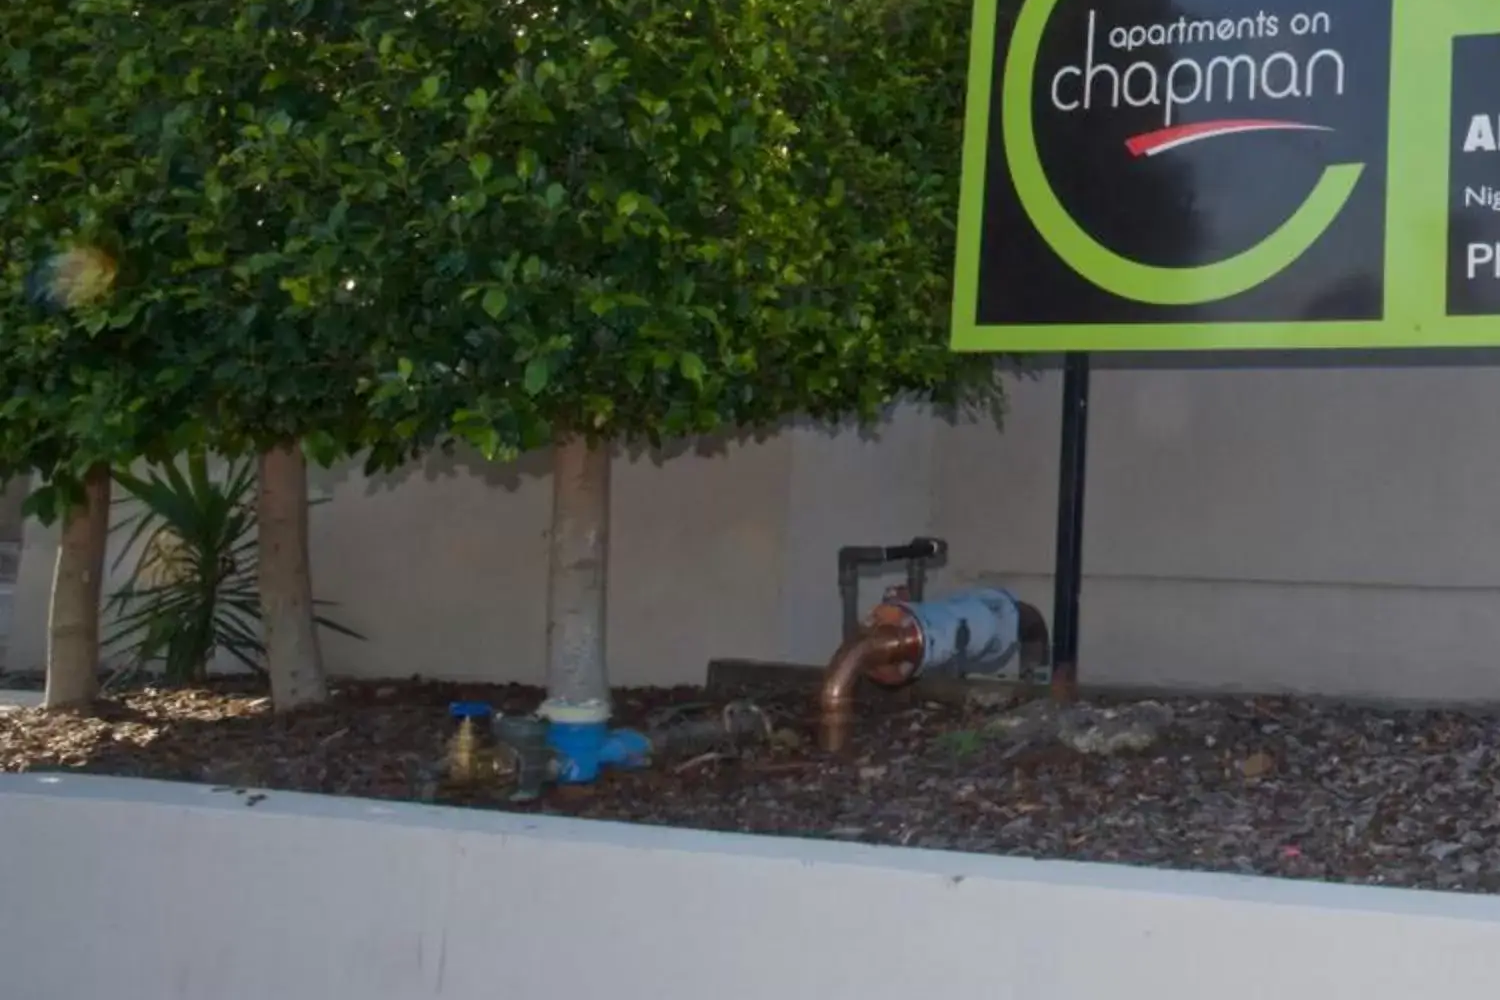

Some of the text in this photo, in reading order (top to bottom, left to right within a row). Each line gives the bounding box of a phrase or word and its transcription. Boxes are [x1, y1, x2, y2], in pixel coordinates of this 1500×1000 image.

[1051, 10, 1344, 127] chapman
[1109, 10, 1331, 51] apartments on
